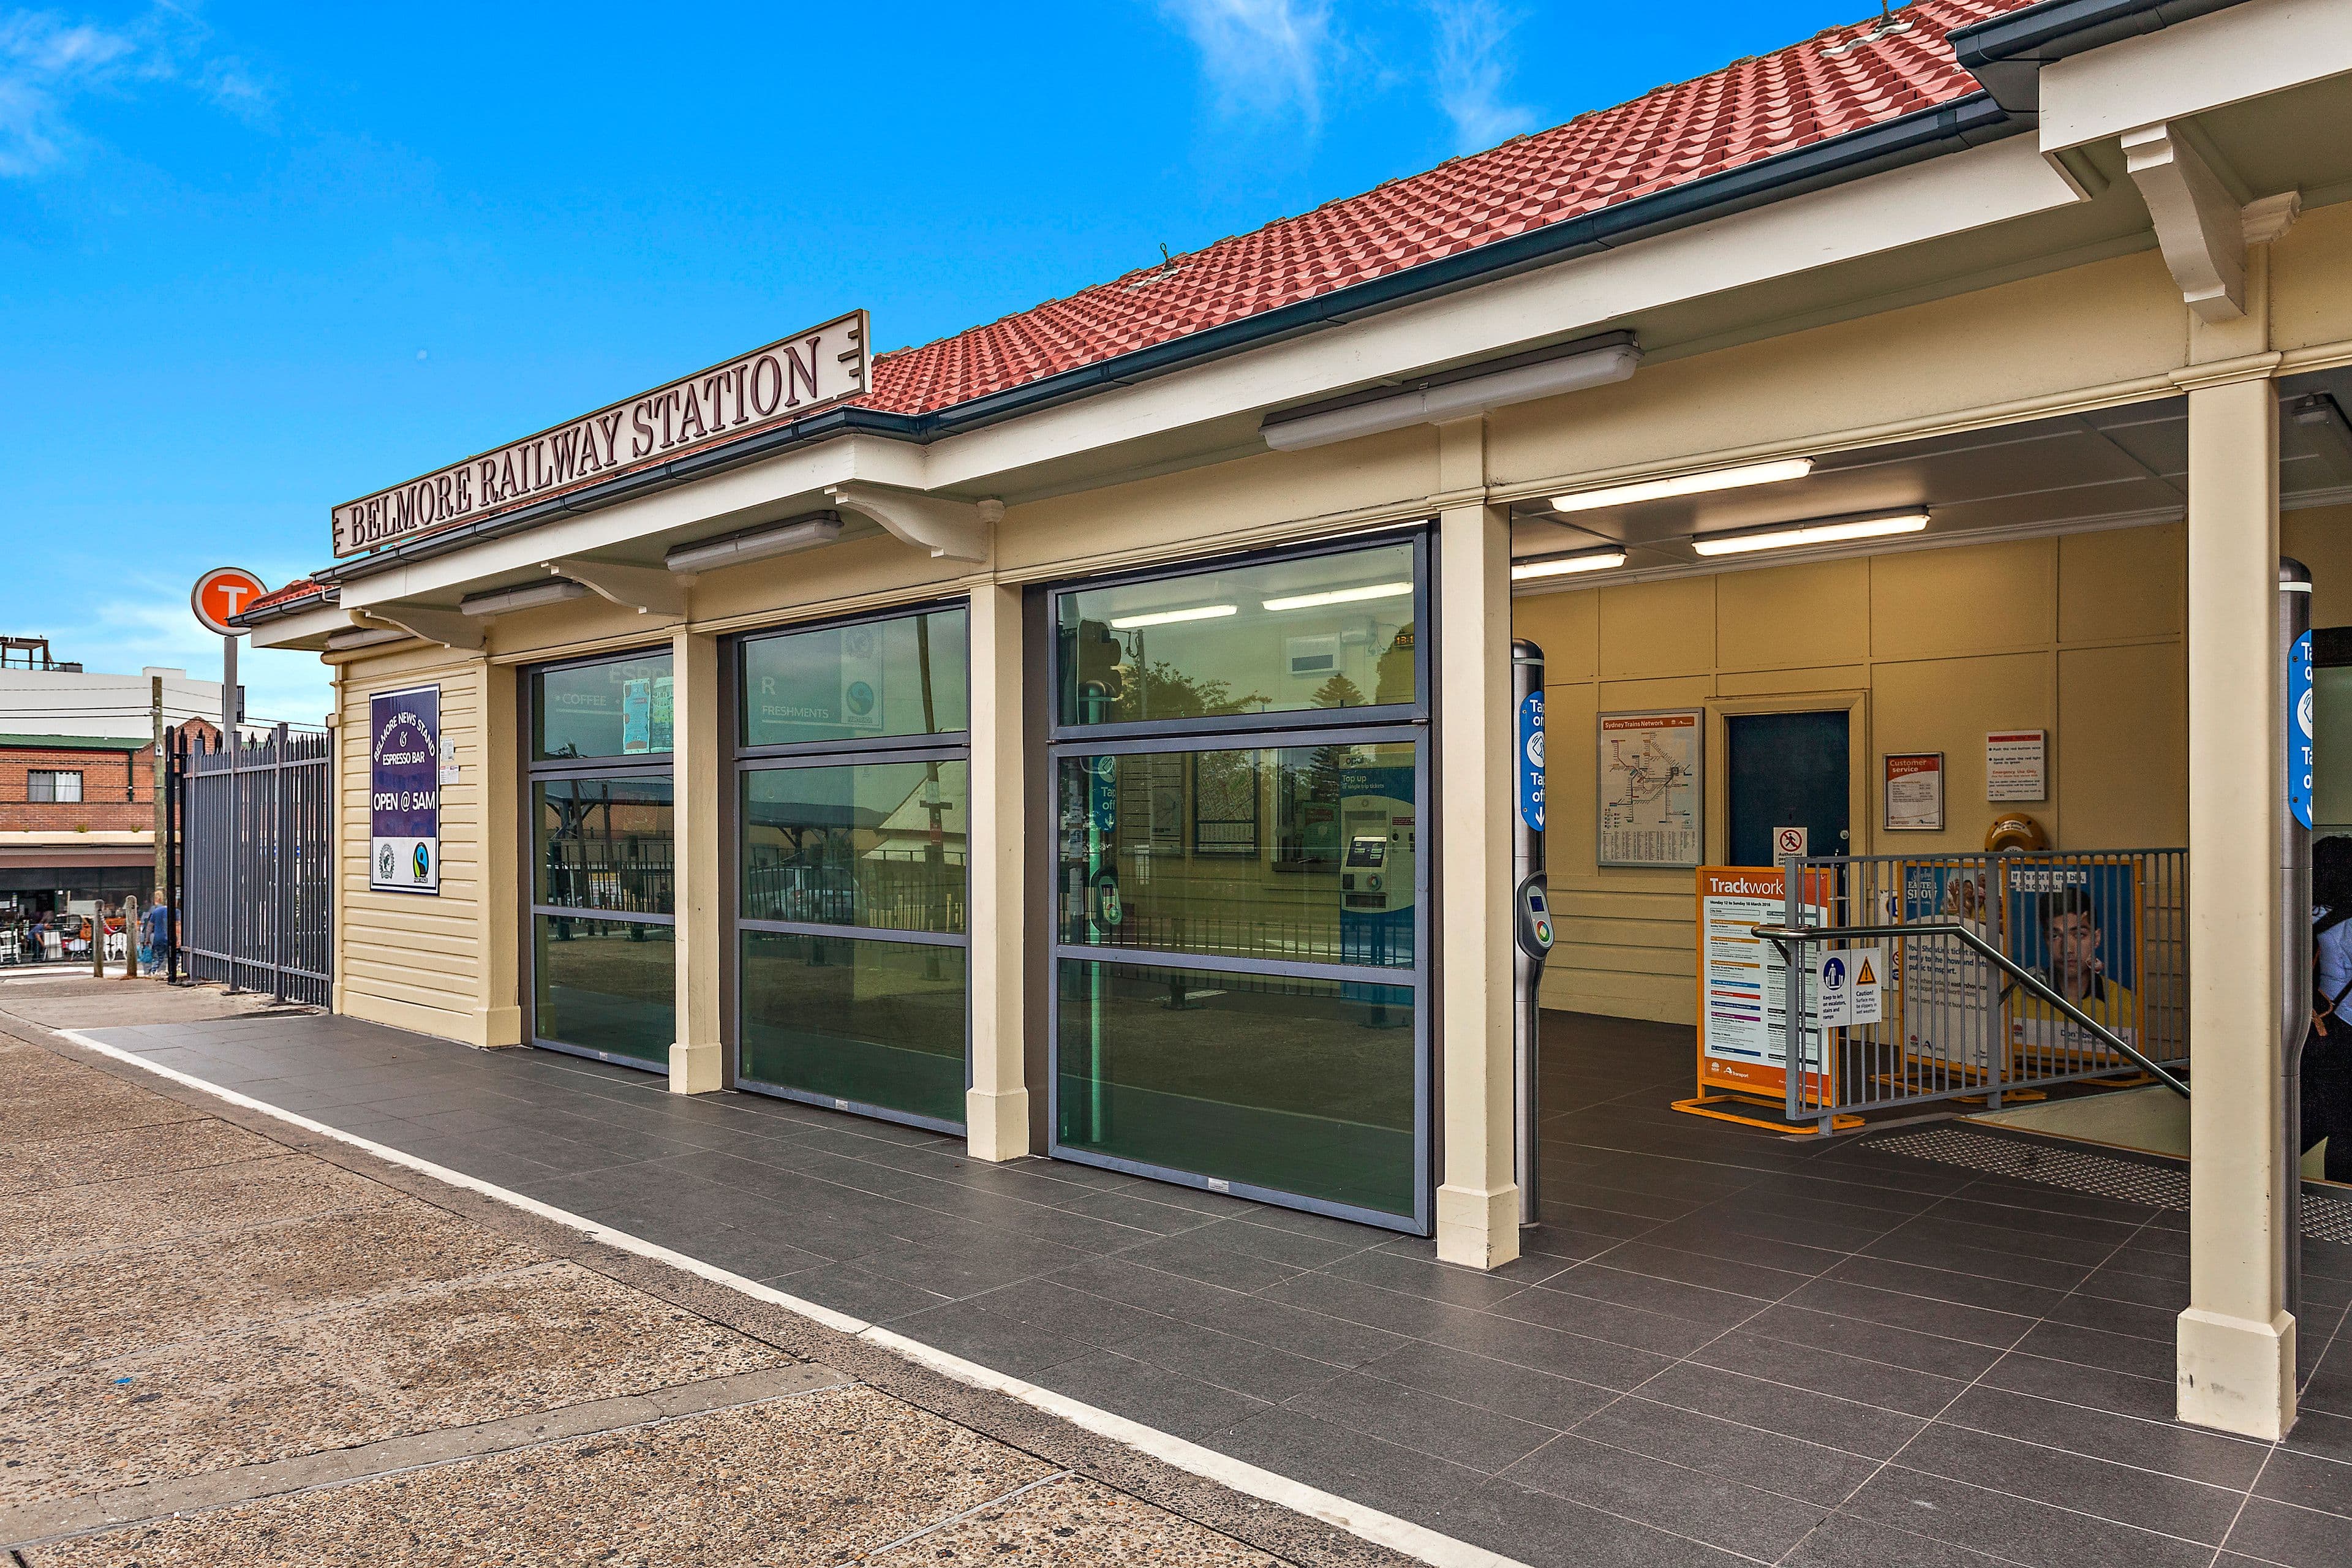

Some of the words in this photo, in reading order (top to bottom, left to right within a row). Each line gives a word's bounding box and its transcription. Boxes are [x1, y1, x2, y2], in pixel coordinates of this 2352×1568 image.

[349, 466, 471, 547] BELMORE
[478, 411, 623, 507] RAILWAY
[632, 336, 821, 458] STATION
[218, 585, 247, 617] T
[609, 663, 673, 684] ESPR
[562, 693, 606, 706] COFFEE
[761, 706, 829, 718] FRESHMENTS
[374, 715, 398, 762] BELMORE
[398, 712, 417, 726] NEWS
[417, 719, 435, 756] STAND
[399, 731, 407, 747] &
[383, 752, 411, 765] ESPRESSO
[412, 751, 425, 763] BAR
[1346, 756, 1364, 766] opal
[1341, 775, 1355, 783] Top
[374, 793, 398, 811] OPEN
[401, 791, 410, 812] @
[412, 791, 435, 810] 5AM
[1709, 877, 1784, 895] Trackwork
